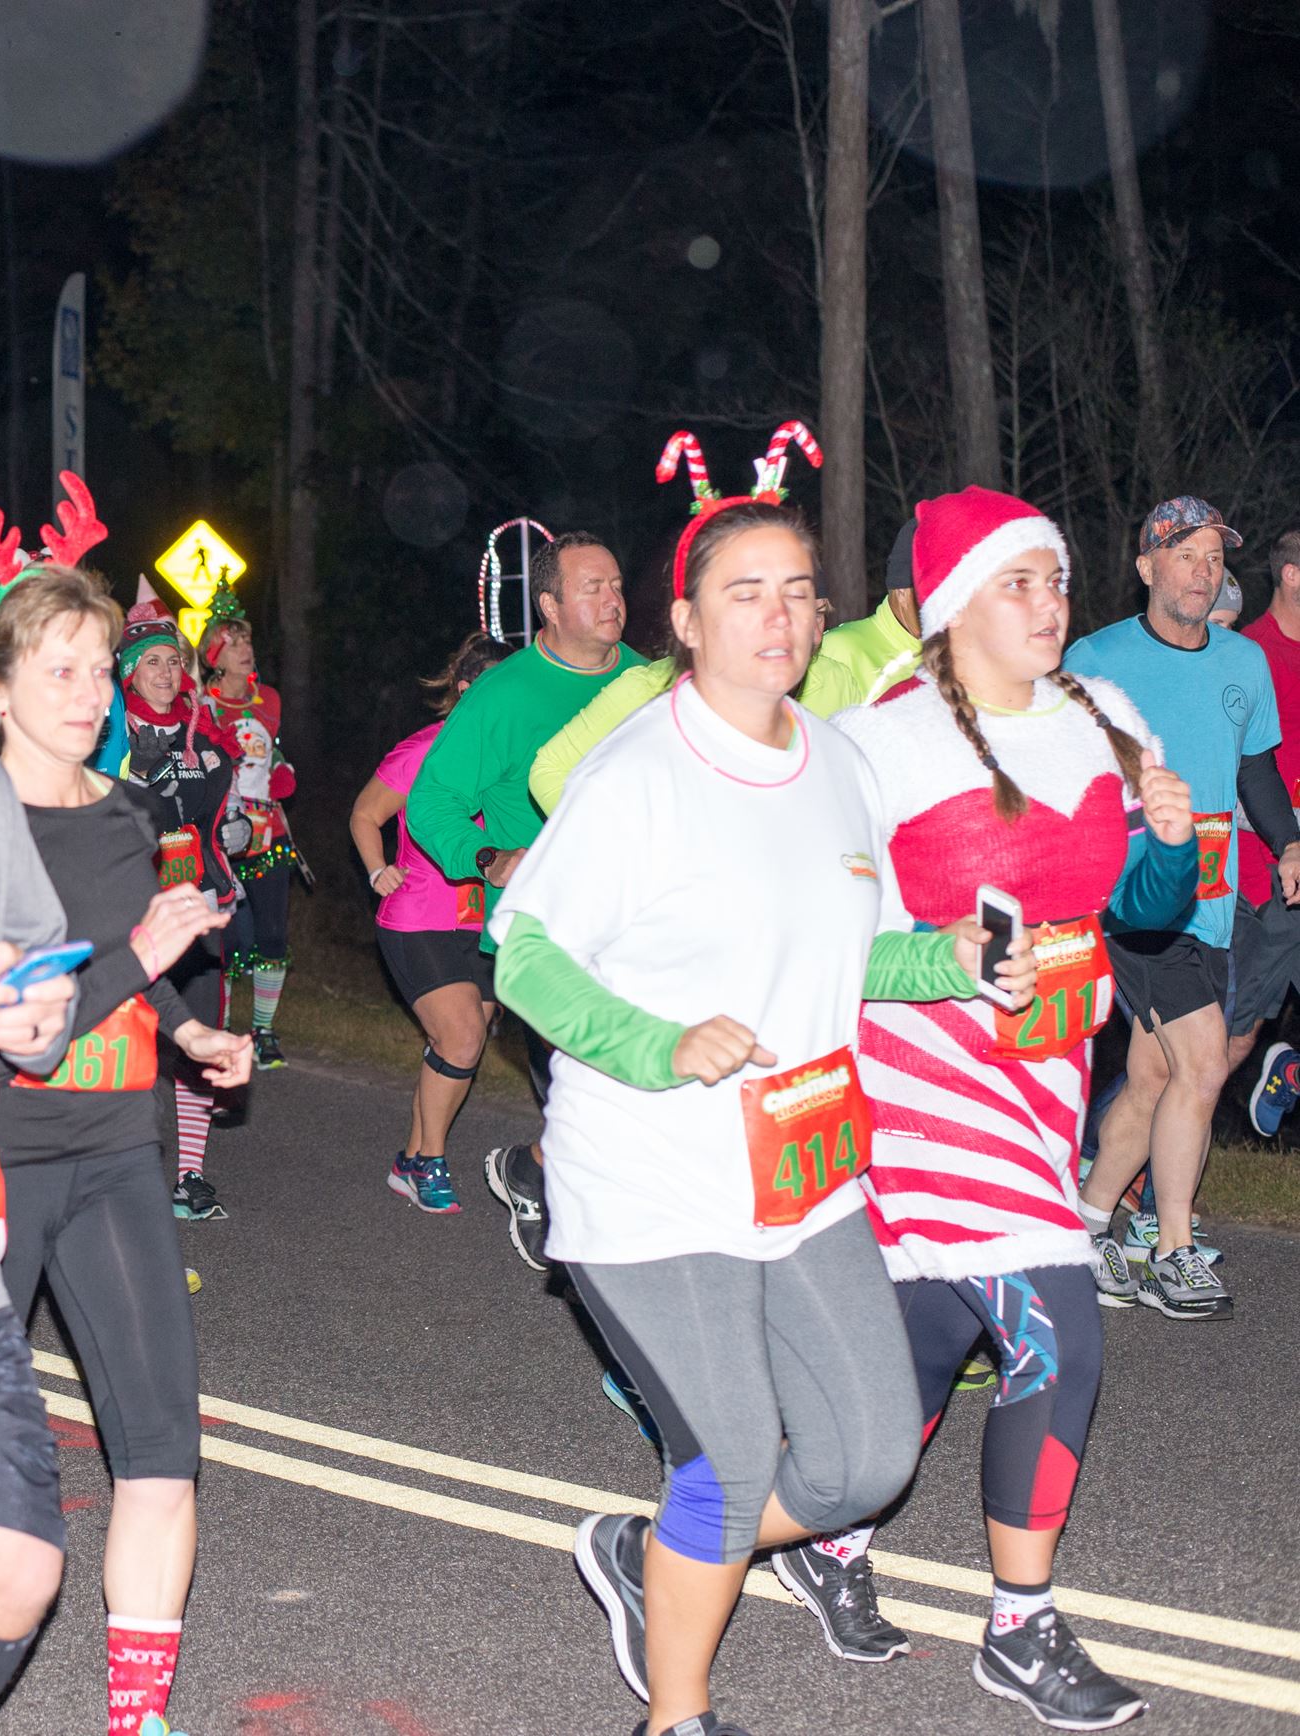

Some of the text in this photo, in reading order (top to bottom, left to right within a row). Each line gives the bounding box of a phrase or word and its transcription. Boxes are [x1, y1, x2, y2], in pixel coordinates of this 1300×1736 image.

[160, 856, 196, 885] 398
[1197, 851, 1220, 884] 3
[1016, 981, 1094, 1048] 211
[774, 1120, 859, 1198] 414
[114, 1648, 167, 1666] JOY
[110, 1690, 147, 1708] JOY
